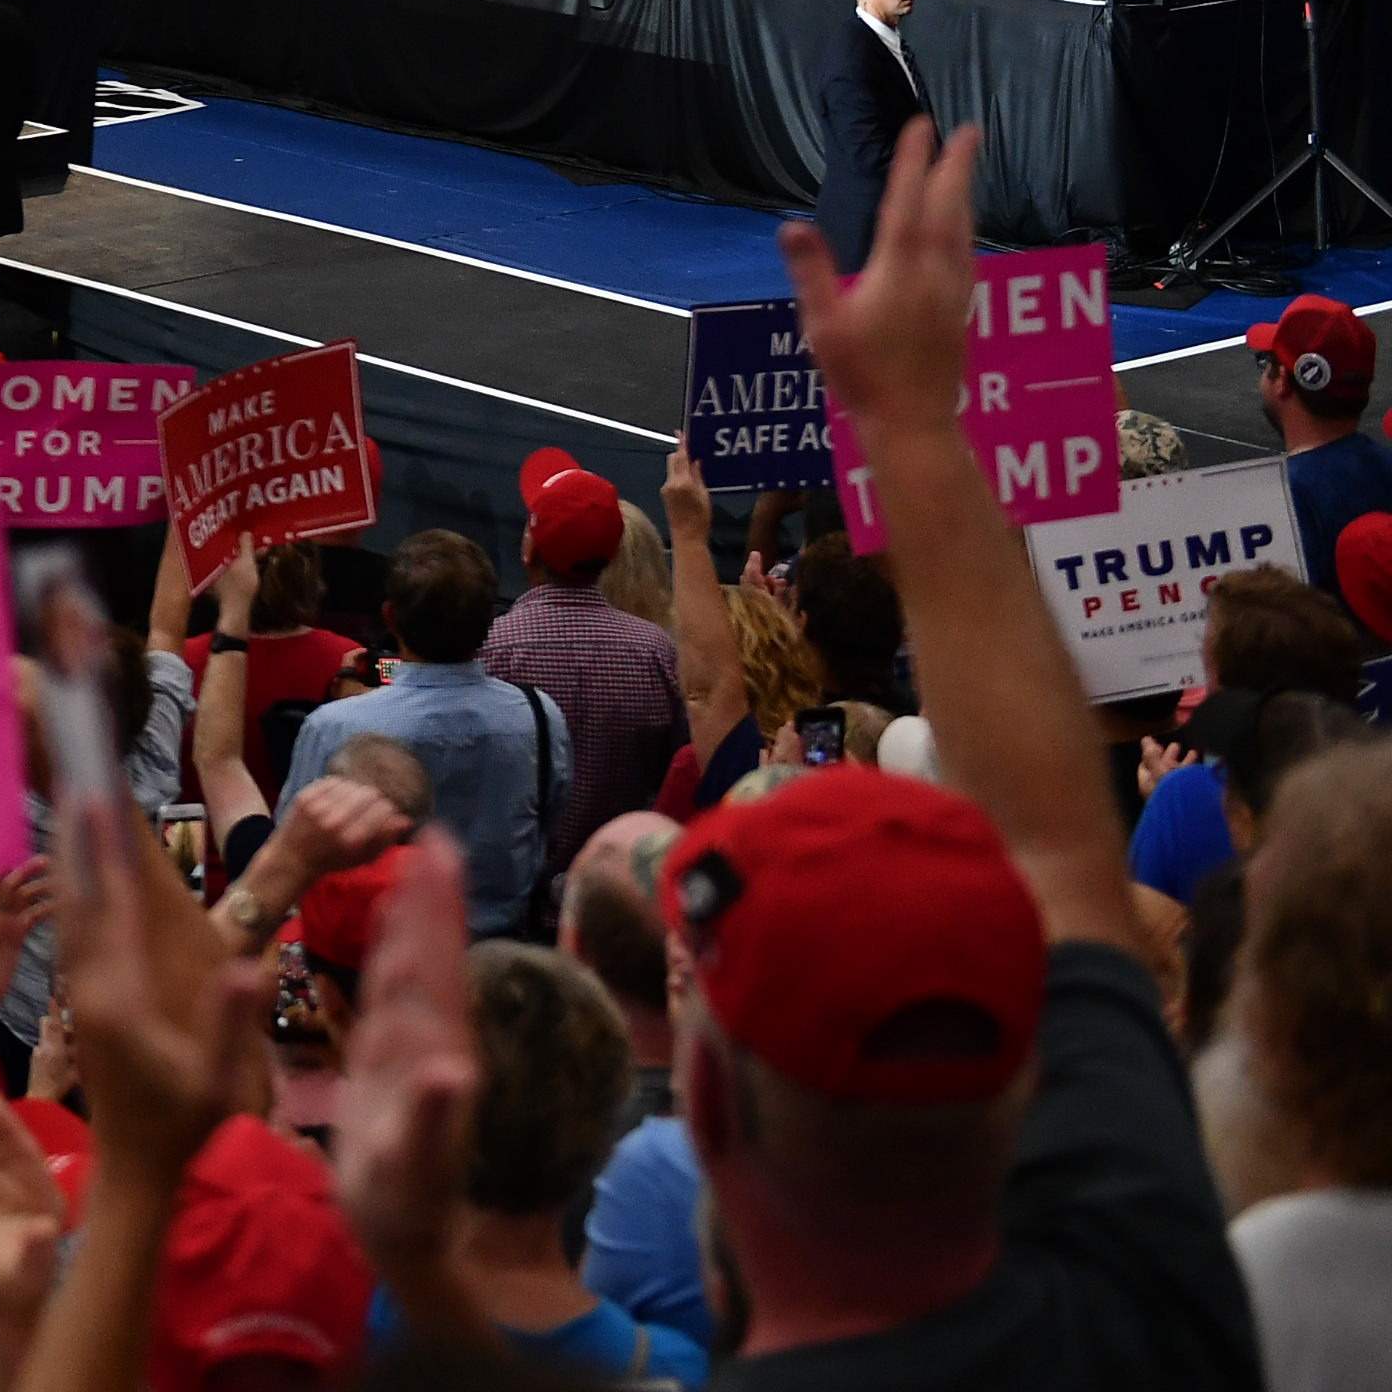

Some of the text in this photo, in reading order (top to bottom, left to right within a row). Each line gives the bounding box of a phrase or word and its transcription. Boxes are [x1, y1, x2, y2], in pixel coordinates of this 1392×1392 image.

[207, 388, 278, 437] MAKE
[15, 429, 103, 457] FOR
[171, 410, 359, 510] AMERICA
[713, 423, 790, 457] SAFE
[187, 465, 347, 548] GREAT AGAIN
[1054, 523, 1275, 590] TRUMP
[1080, 615, 1175, 640] MAKE AMERICA
